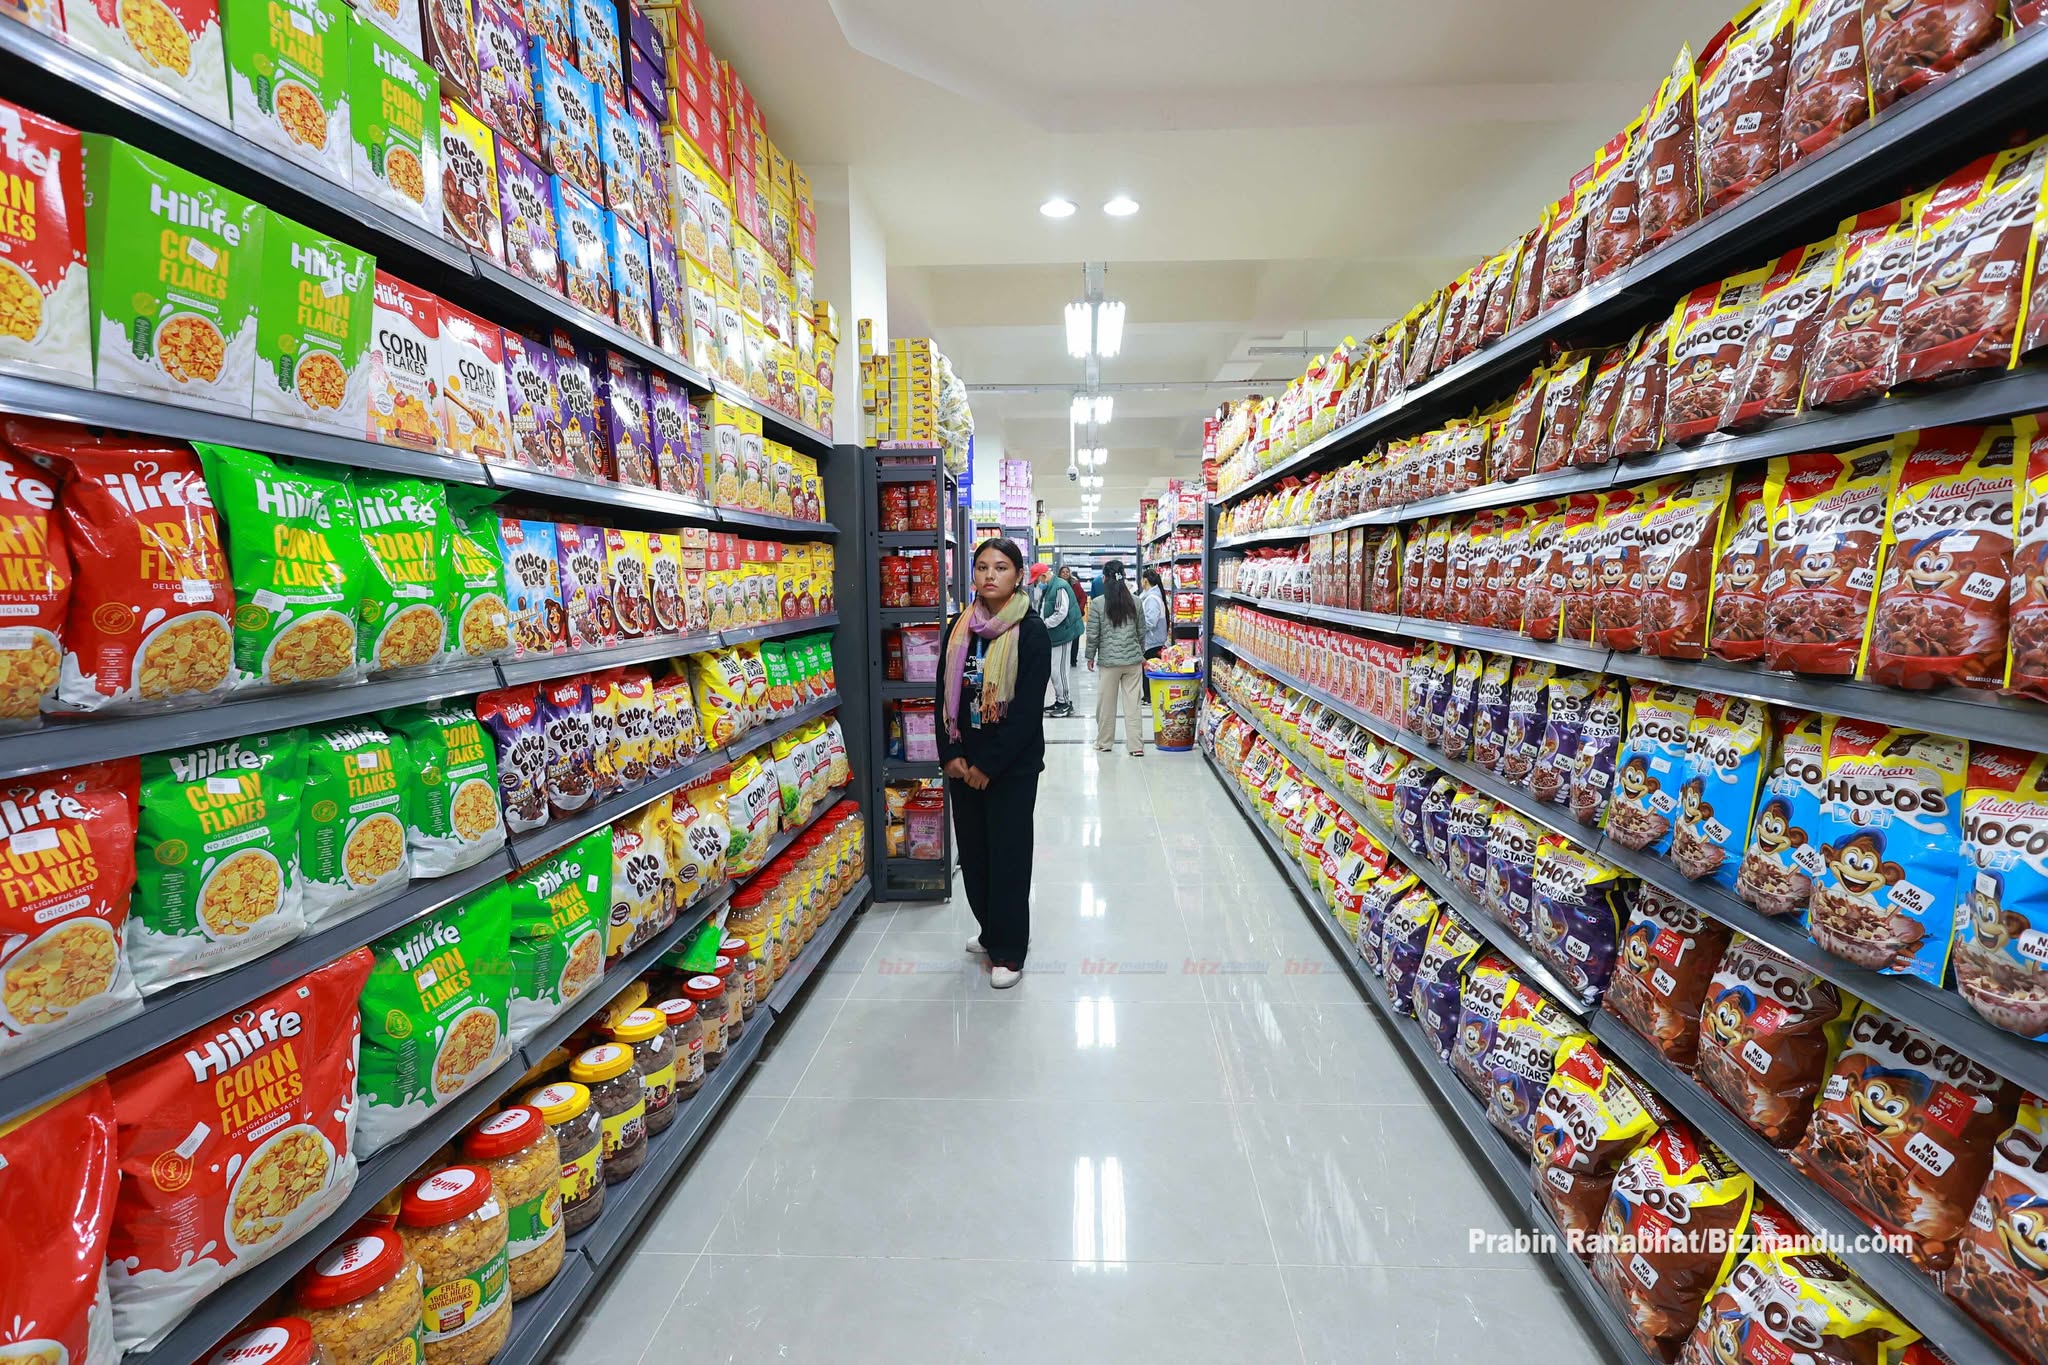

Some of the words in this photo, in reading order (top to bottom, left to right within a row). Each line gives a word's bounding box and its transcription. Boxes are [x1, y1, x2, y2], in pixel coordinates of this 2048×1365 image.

[584, 5, 610, 40] CHOCO
[270, 26, 323, 78] FLAKES
[490, 31, 521, 70] CHOCO
[1838, 51, 1849, 59] No
[497, 52, 521, 82] PLUS
[381, 79, 423, 117] CORN
[557, 85, 587, 122] CHOCO
[564, 103, 586, 128] PLUS
[1744, 117, 1755, 125] No
[1737, 123, 1757, 132] Maida
[443, 137, 483, 174] CHOCO
[452, 158, 480, 186] PLUS
[511, 183, 542, 215] CHOCO
[150, 183, 240, 246] Hilife
[519, 201, 540, 225] PLUS
[159, 260, 227, 300] FLAKES
[1983, 270, 2008, 281] Maida
[1993, 265, 2005, 274] No
[374, 284, 414, 315] Hilife
[298, 305, 348, 338] FLAKES
[379, 330, 427, 364] CORN
[504, 336, 525, 354] Hilife
[555, 335, 575, 357] Hilife
[1773, 349, 1790, 360] Maida
[1781, 345, 1789, 353] No
[386, 351, 426, 376] FLAKES
[459, 358, 496, 388] CORN
[464, 378, 496, 398] FLAKES
[517, 370, 548, 397] CHOCO
[561, 368, 591, 398] CHOCO
[524, 388, 545, 407] PLUS
[568, 391, 591, 416] PLUS
[657, 406, 681, 430] CHOCO
[661, 422, 680, 443] PLUS
[1910, 449, 1969, 465] Kellogg's
[1790, 469, 1836, 485] Kellogg's
[1813, 484, 1881, 511] MultiGrain
[1928, 477, 2013, 501] MultiGrain
[254, 479, 331, 529] Hilife
[1650, 506, 1696, 527] MultiGrain
[501, 523, 524, 540] Hilife
[560, 527, 580, 543] Hilife
[607, 534, 626, 548] Hilife
[273, 524, 335, 562] CORN
[273, 559, 347, 587] FLAKES
[515, 553, 548, 574] CHOCO
[572, 555, 600, 575] CHOCO
[617, 557, 642, 575] CHOCO
[655, 557, 676, 575] CHOCO
[522, 570, 546, 588] PLUS
[578, 571, 598, 586] PLUS
[623, 571, 639, 585] PLUS
[660, 571, 675, 587] PLUS
[1669, 580, 1684, 588] Maida
[1861, 571, 1874, 581] No
[1979, 577, 1992, 589] No
[1965, 583, 1995, 600] Maida
[554, 687, 579, 703] Hilife
[620, 682, 643, 696] Hilife
[506, 704, 531, 724] Hilife
[654, 715, 676, 731] CHOCO
[321, 725, 391, 751] Hilife
[442, 724, 480, 749] CORN
[550, 716, 589, 742] CHOCO
[657, 727, 675, 739] PLUS
[1833, 726, 1879, 746] Kellogg's
[511, 735, 545, 767] CHOCO
[559, 734, 589, 752] PLUS
[169, 743, 260, 783] Hilife
[520, 752, 544, 776] PLUS
[1556, 761, 1571, 771] Maida
[1830, 763, 1916, 780] MultiGrain
[348, 772, 396, 798] FLAKES
[1590, 777, 1605, 788] Maida
[747, 784, 766, 808] CORN
[1652, 798, 1670, 812] Maida
[1660, 794, 1669, 803] No
[199, 801, 266, 834] FLAKES
[1833, 803, 1896, 828] DUET
[222, 837, 244, 847] ADDED
[245, 829, 267, 840] SUGAR
[687, 825, 719, 850] CHOCO
[1705, 826, 1723, 842] Maida
[1713, 824, 1722, 834] No
[699, 841, 722, 861] PLUS
[1966, 844, 2021, 872] DUET
[1, 857, 99, 908] FLAKES
[535, 862, 581, 900] Hilife
[637, 872, 661, 898] PLUS
[22, 894, 73, 913] DELIGHTFUL
[74, 884, 95, 896] TASTE
[1892, 891, 1923, 913] Maida
[1905, 887, 1921, 900] No
[38, 898, 87, 920] ORIGINAL
[552, 899, 589, 929] FLAKES
[1511, 901, 1525, 912] Maida
[392, 921, 461, 972] Hilife
[1567, 948, 1586, 960] Maida
[1573, 942, 1583, 951] No
[1655, 943, 1674, 958] 899/-
[1653, 977, 1670, 994] Maida
[1660, 974, 1669, 984] No
[420, 970, 472, 1013] FLAKES
[183, 1008, 302, 1083] Hilife
[1753, 1048, 1763, 1060] No
[1744, 1051, 1766, 1072] Maida
[214, 1043, 299, 1107] CORN
[1521, 1066, 1549, 1082] STARS
[220, 1073, 303, 1135] FLAKES
[232, 1111, 279, 1139] DELIGHTFUL
[280, 1098, 301, 1113] TASTE
[250, 1114, 289, 1140] ORIGINAL
[484, 1112, 521, 1131] Hilife
[1663, 1124, 1692, 1172] Kellogg's
[1908, 1144, 1943, 1173] Maida
[1922, 1142, 1939, 1158] No
[432, 1176, 462, 1192] Hilife
[1549, 1175, 1569, 1191] Maida
[1555, 1170, 1566, 1181] No
[341, 1243, 364, 1272] Hilife
[1640, 1260, 1651, 1275] No
[1632, 1264, 1653, 1287] Maida
[430, 1294, 450, 1304] 150G
[450, 1284, 473, 1297] HILIFE
[440, 1281, 461, 1294] FREE
[428, 1291, 474, 1311] SOYACHUNKS!
[221, 1343, 279, 1362] Hilife
